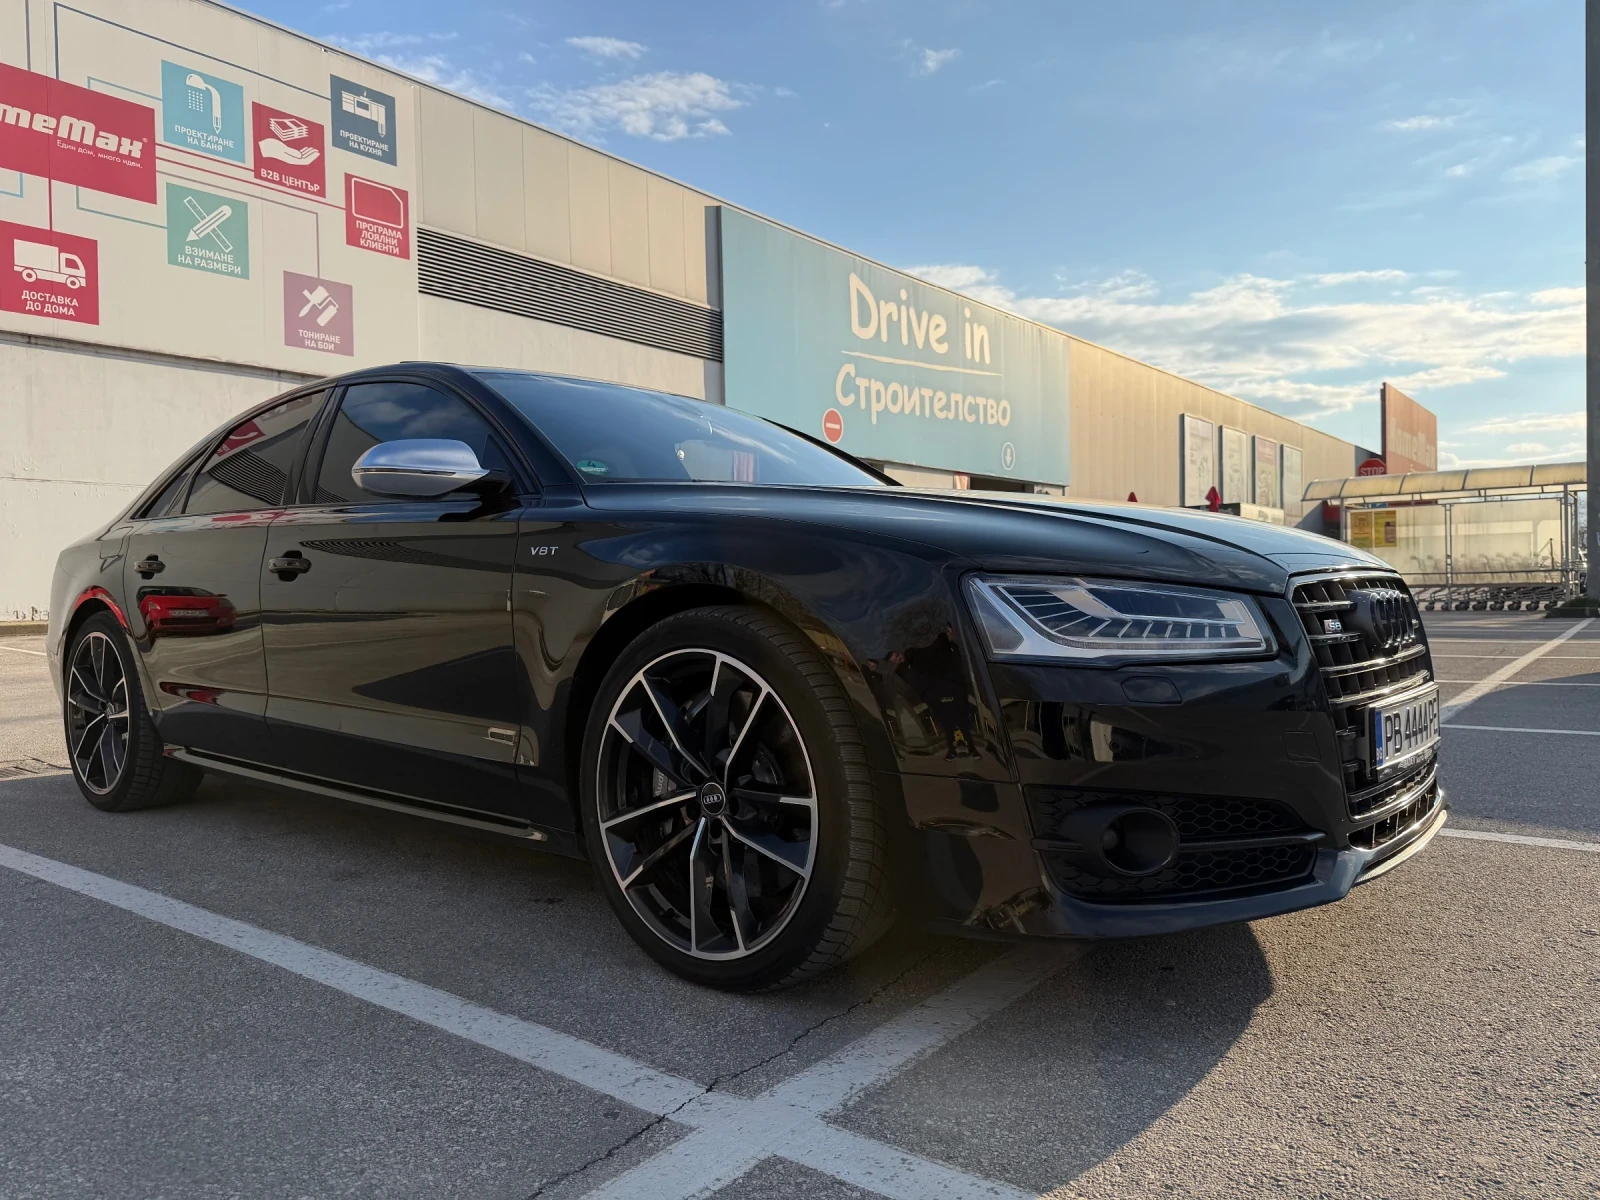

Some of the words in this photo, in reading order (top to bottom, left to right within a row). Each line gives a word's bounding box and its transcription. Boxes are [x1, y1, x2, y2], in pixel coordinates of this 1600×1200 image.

[174, 124, 235, 148] ПРОЕКТИРАНЕ
[187, 136, 199, 146] НА
[200, 140, 223, 152] БАНЯ
[340, 129, 389, 152] ПРОЕКТИРАНЕ
[57, 139, 76, 151] Един
[77, 147, 96, 158] дом,
[98, 153, 121, 163] много
[348, 140, 359, 149] НА
[360, 144, 383, 157] КУХНЯ
[282, 174, 320, 192] ЦЕНТЪР
[356, 220, 403, 240] ПРОГРАМА
[361, 230, 398, 247] ЛОЯЛНИ
[185, 245, 234, 264] ВЗИМАНЕ
[360, 237, 400, 255] КЛИЕНТИ
[178, 254, 192, 265] НА
[194, 257, 241, 275] РАЗМЕРИ
[21, 289, 79, 307] ДОСТАВКА
[25, 300, 42, 312] ДО
[43, 303, 76, 317] ДОМА
[849, 272, 948, 354] Drive
[963, 307, 991, 365] in
[298, 329, 341, 344] ТОНИРАНЕ
[304, 339, 317, 348] НА
[317, 341, 335, 351] БОИ
[835, 363, 1011, 427] Строителство
[1360, 466, 1385, 477] STOP
[530, 546, 559, 556] V8T
[1330, 621, 1342, 631] S8
[1384, 711, 1403, 760] PB
